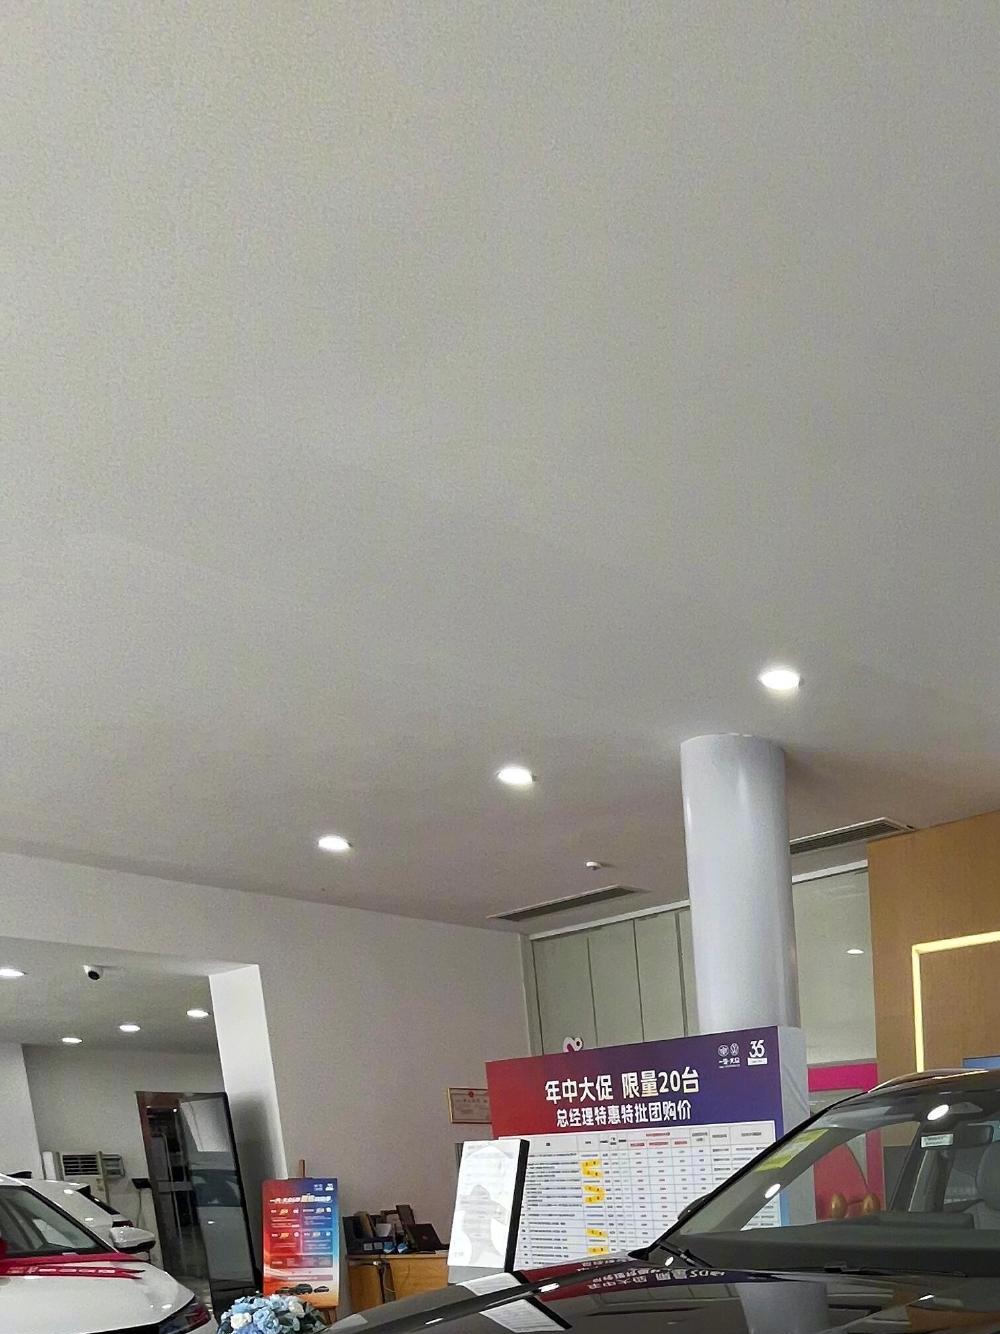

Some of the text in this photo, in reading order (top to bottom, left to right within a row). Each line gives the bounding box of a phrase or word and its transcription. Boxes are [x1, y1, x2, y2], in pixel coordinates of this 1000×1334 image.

[545, 1066, 699, 1105] 年中大促 限量20台
[556, 1099, 692, 1128] 总经理特惠特批团购价
